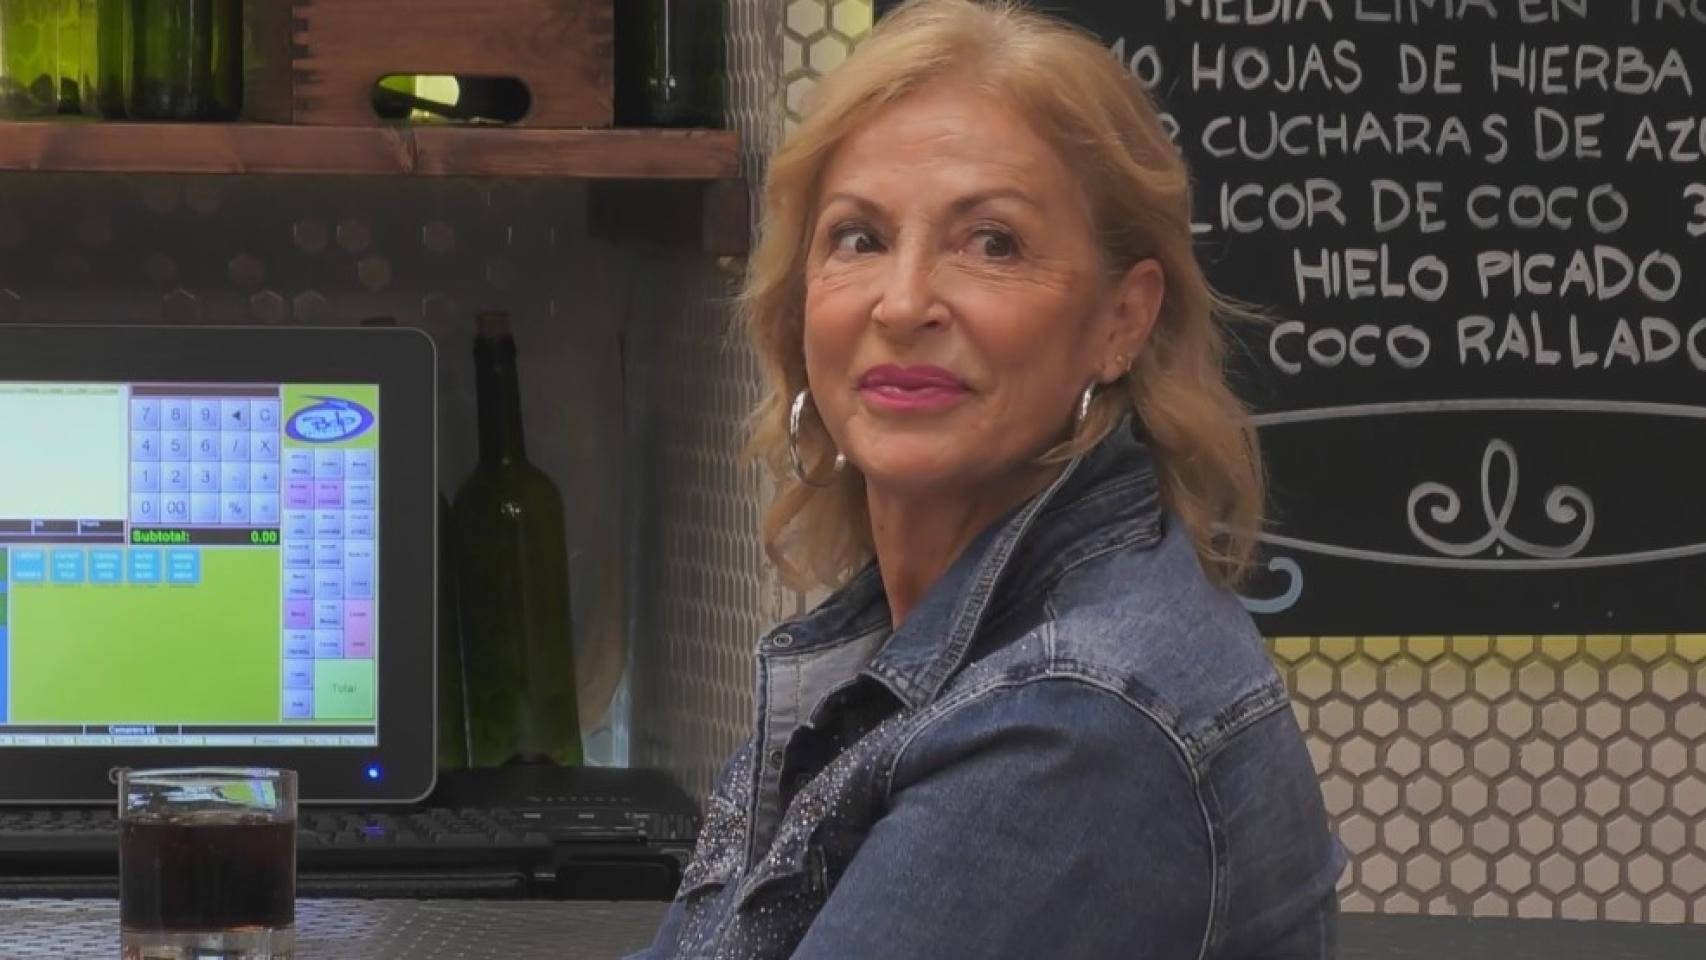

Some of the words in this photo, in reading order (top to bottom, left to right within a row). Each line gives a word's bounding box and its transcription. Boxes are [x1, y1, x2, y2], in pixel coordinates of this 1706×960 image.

[1192, 40, 1362, 94] HOJAS
[1398, 43, 1462, 94] DE
[1490, 41, 1693, 96] HIERBA
[1201, 110, 1508, 164] CUCHARAS
[1534, 106, 1605, 161] DE
[1625, 115, 1706, 162] AZ
[1370, 179, 1446, 233] DE
[1466, 183, 1629, 234] COCO
[1293, 243, 1449, 304] HIELO
[1477, 245, 1682, 301] PICADO
[1269, 320, 1431, 374] COCO
[142, 407, 151, 421] 7
[171, 407, 181, 421] 8
[201, 407, 210, 421] 9
[141, 440, 150, 452] 4
[171, 439, 181, 452] 5
[201, 439, 210, 452] 6
[171, 470, 181, 484] 2
[201, 470, 210, 483] 3
[141, 501, 151, 514] 0
[167, 501, 186, 514] 00
[132, 529, 190, 545] Subtotal:
[250, 529, 277, 545] 0.00
